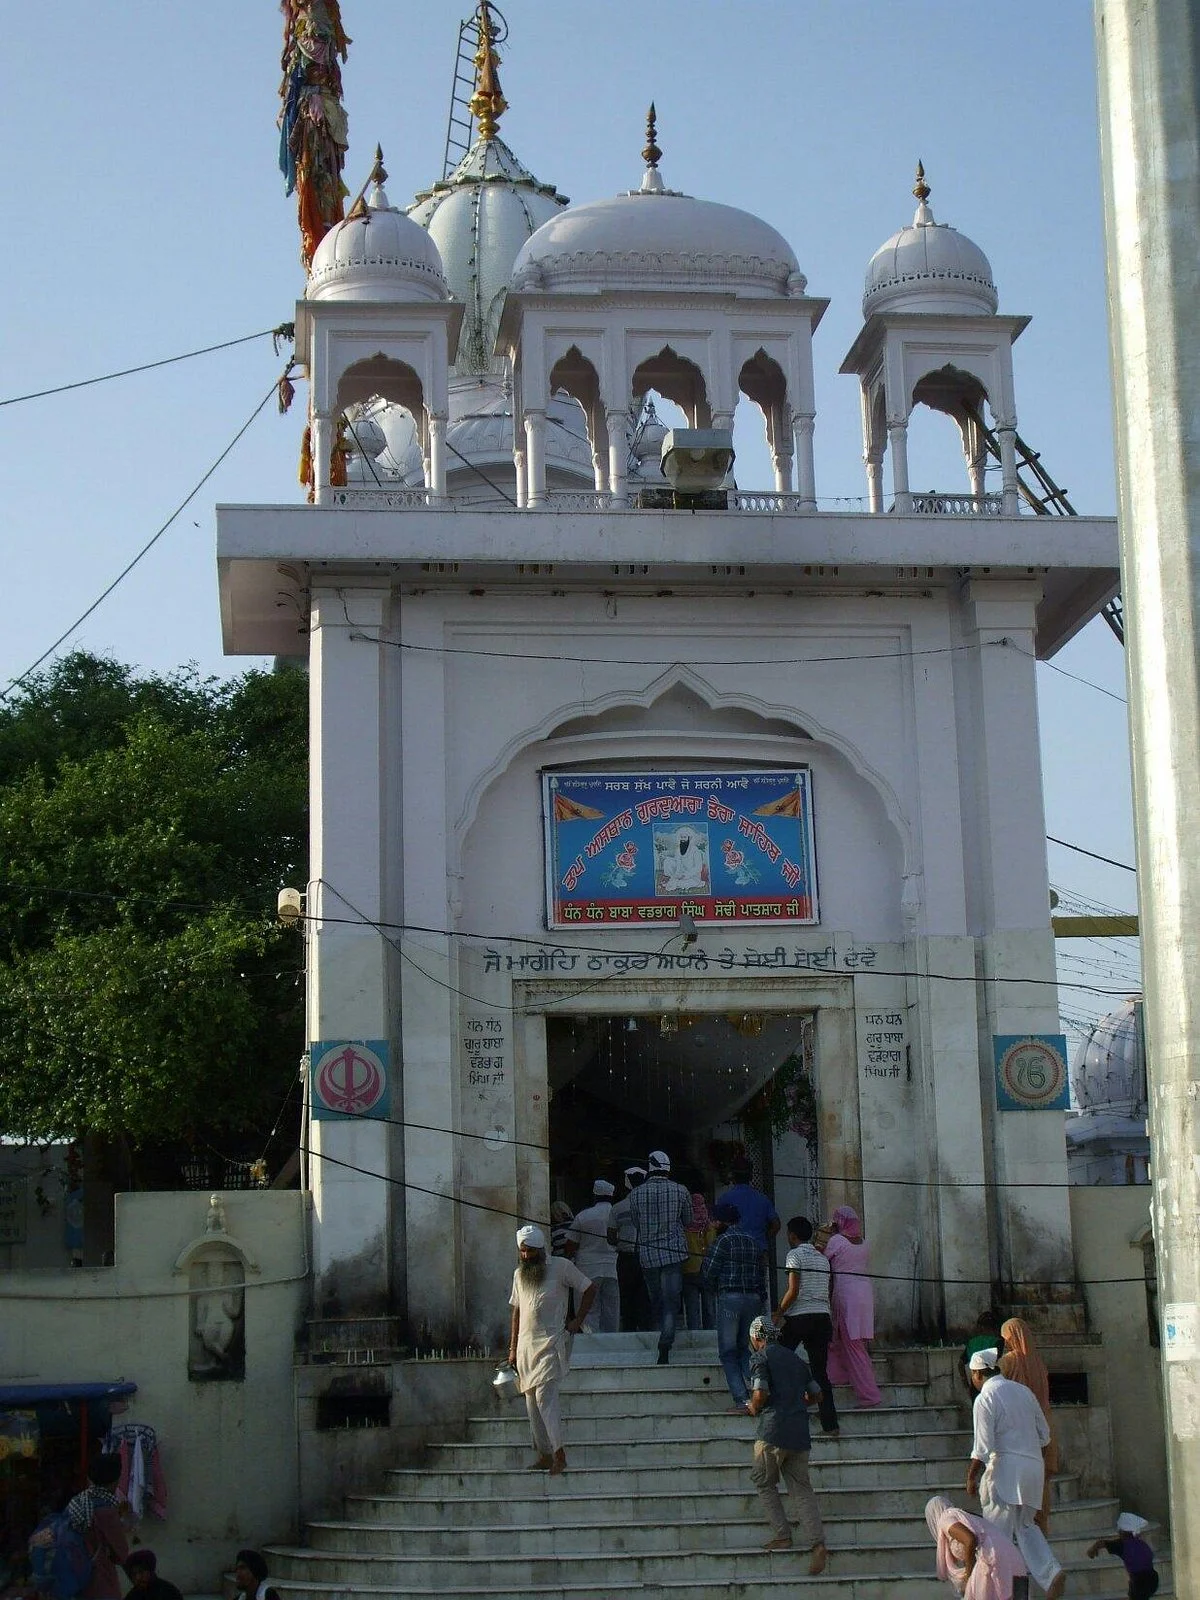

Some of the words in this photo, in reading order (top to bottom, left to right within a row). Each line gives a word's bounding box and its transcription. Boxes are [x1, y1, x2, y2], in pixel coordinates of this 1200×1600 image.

[605, 781, 630, 791] ਸਰਬ
[680, 778, 690, 789] ਜੋ
[635, 795, 703, 824] ਗੁਰਦੁਆਰਾ
[738, 815, 782, 863] ਸਾਹਿਬ
[781, 858, 801, 888] ਜੀ
[564, 902, 582, 919] ਧੰਨ
[586, 902, 604, 919] ਧੰਨ
[608, 906, 633, 918] ਬਾਬਾ
[638, 905, 677, 918] ਵਡਭਾਗ
[681, 900, 705, 917] ਸਿੰਘ
[715, 899, 736, 916] ਸੋਢੀ
[786, 898, 799, 915] ਜੀ
[483, 946, 501, 973] ਜੋ
